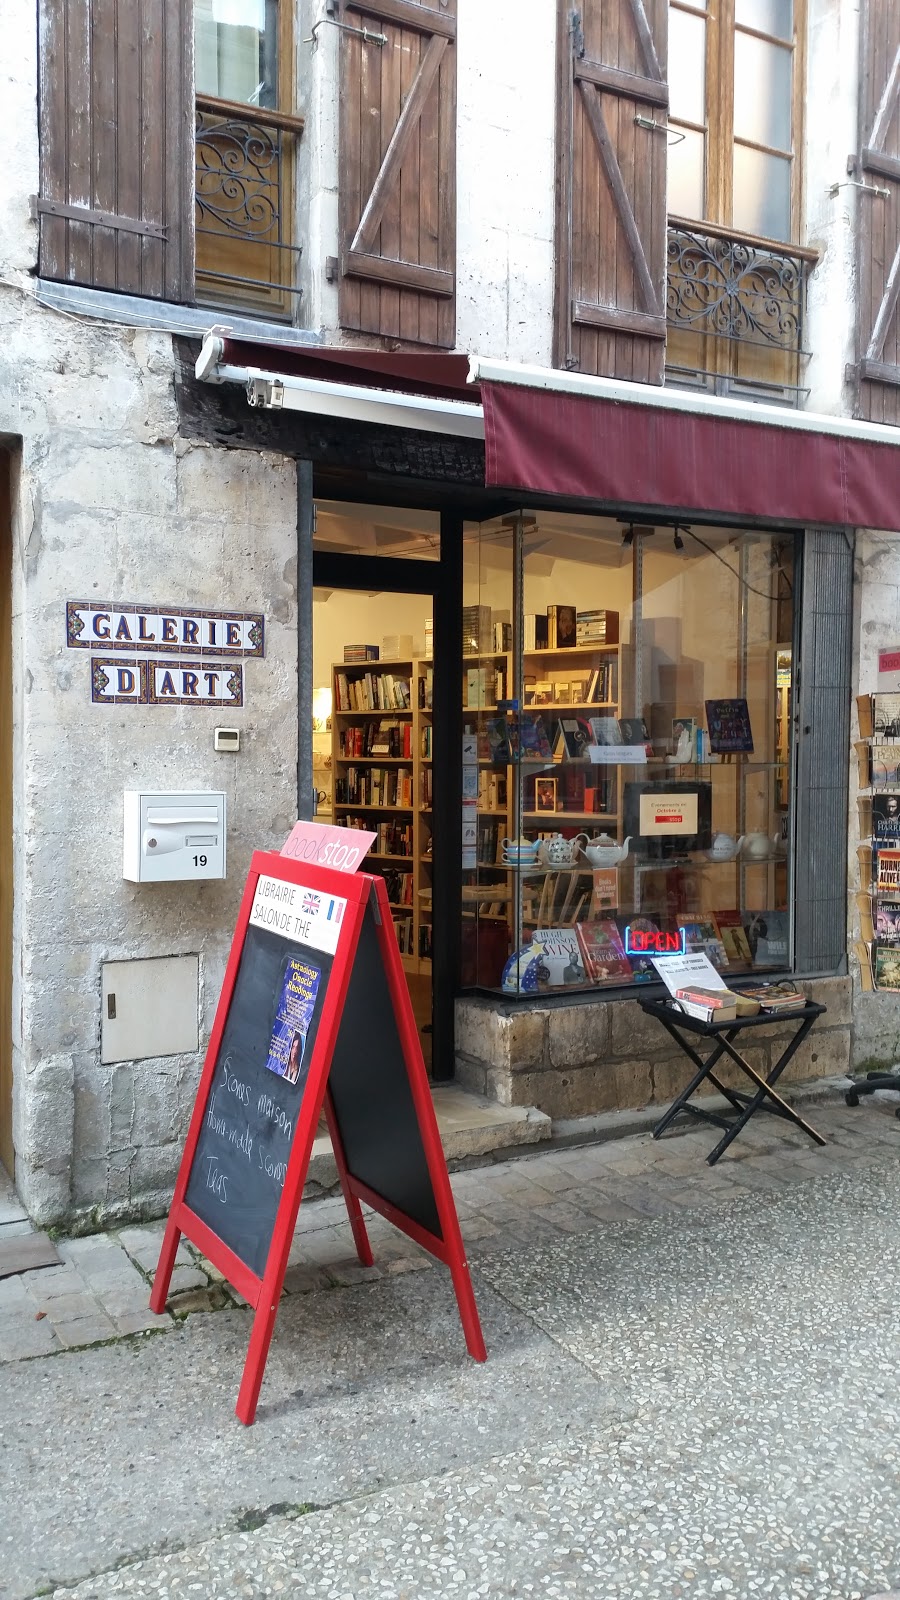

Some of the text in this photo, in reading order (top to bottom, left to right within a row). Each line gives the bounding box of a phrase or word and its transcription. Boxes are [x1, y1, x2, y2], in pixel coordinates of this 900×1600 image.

[92, 613, 242, 647] GALERIE
[116, 668, 220, 698] D ART
[192, 855, 207, 868] 19
[258, 880, 296, 906] LIBRAIRIE
[254, 904, 312, 938] SALON DE THE
[544, 944, 580, 956] WINE
[632, 930, 680, 951] OPEN
[590, 952, 624, 962] Garden
[290, 960, 318, 980] Astrology
[292, 972, 312, 988] Oracle
[288, 980, 313, 1000] Readings
[220, 1056, 292, 1140] Scones maison
[206, 1156, 228, 1203] Teas
